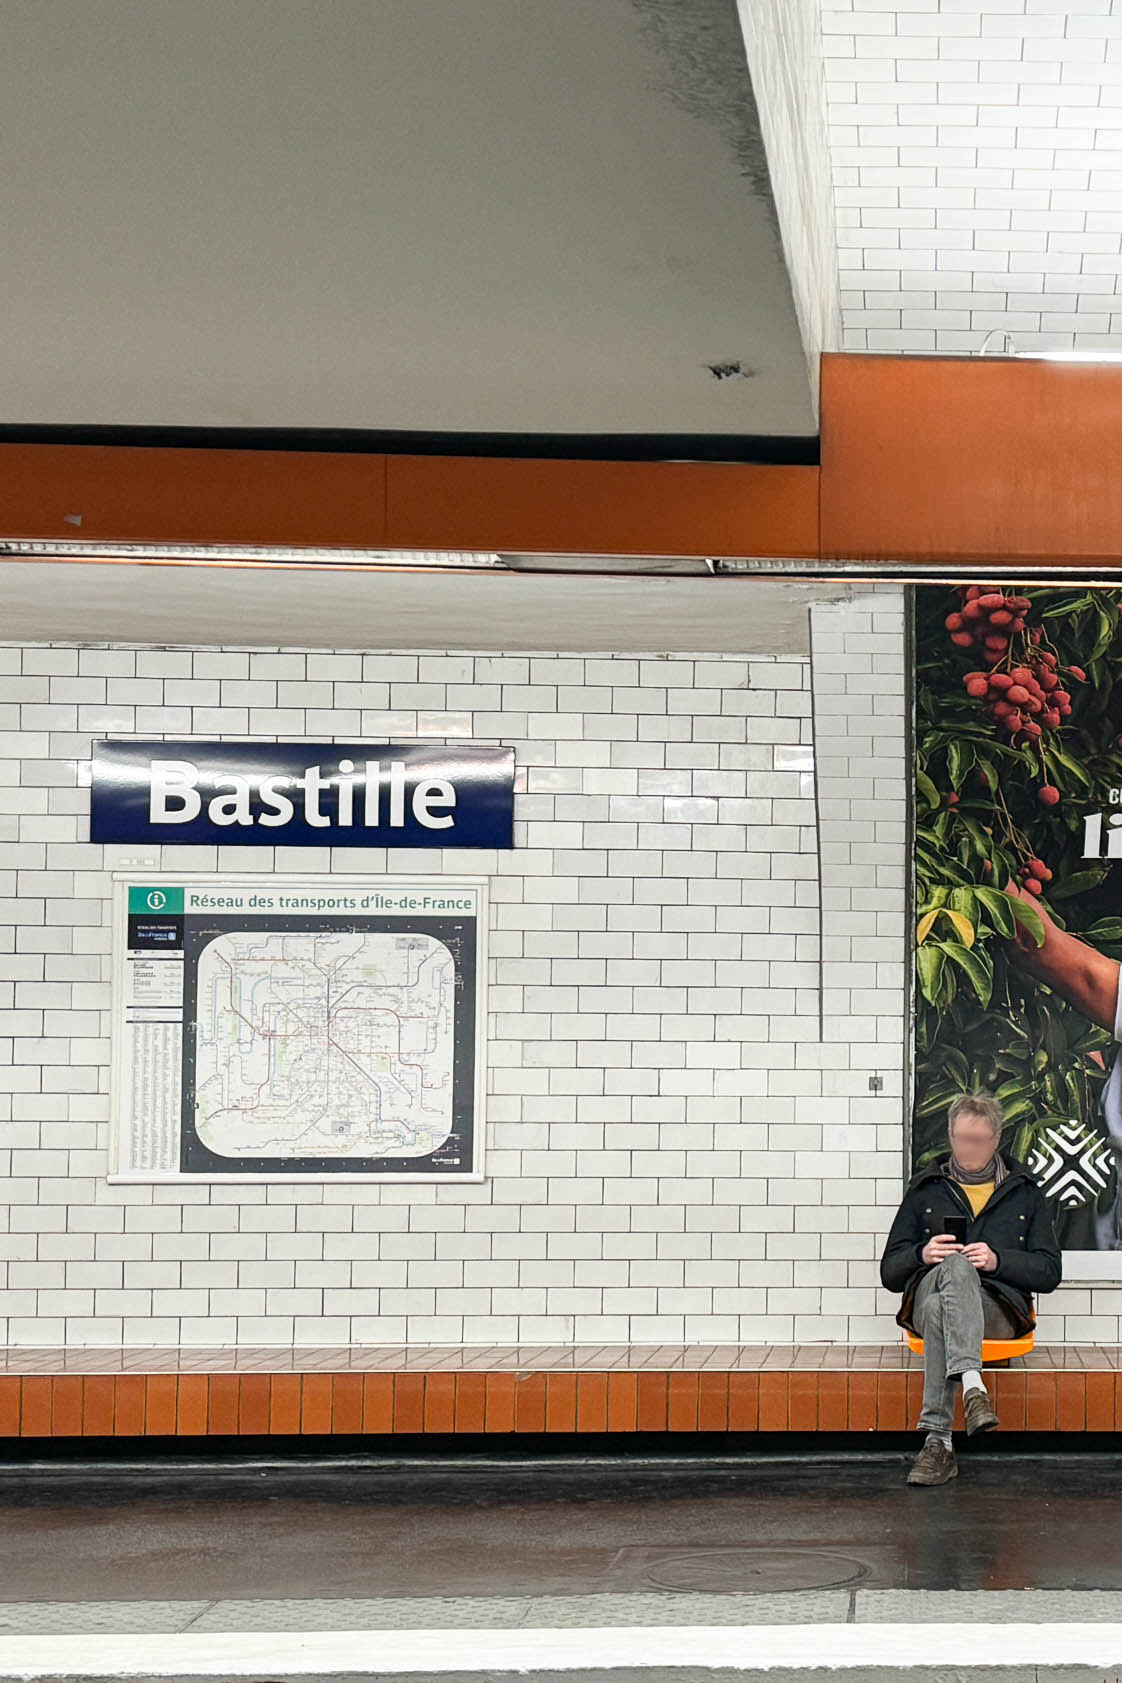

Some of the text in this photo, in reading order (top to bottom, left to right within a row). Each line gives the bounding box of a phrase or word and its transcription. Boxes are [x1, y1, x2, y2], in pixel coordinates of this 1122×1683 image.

[149, 759, 457, 830] Bastille
[190, 894, 244, 908] Réseau
[249, 895, 274, 908] des
[279, 896, 356, 910] transports
